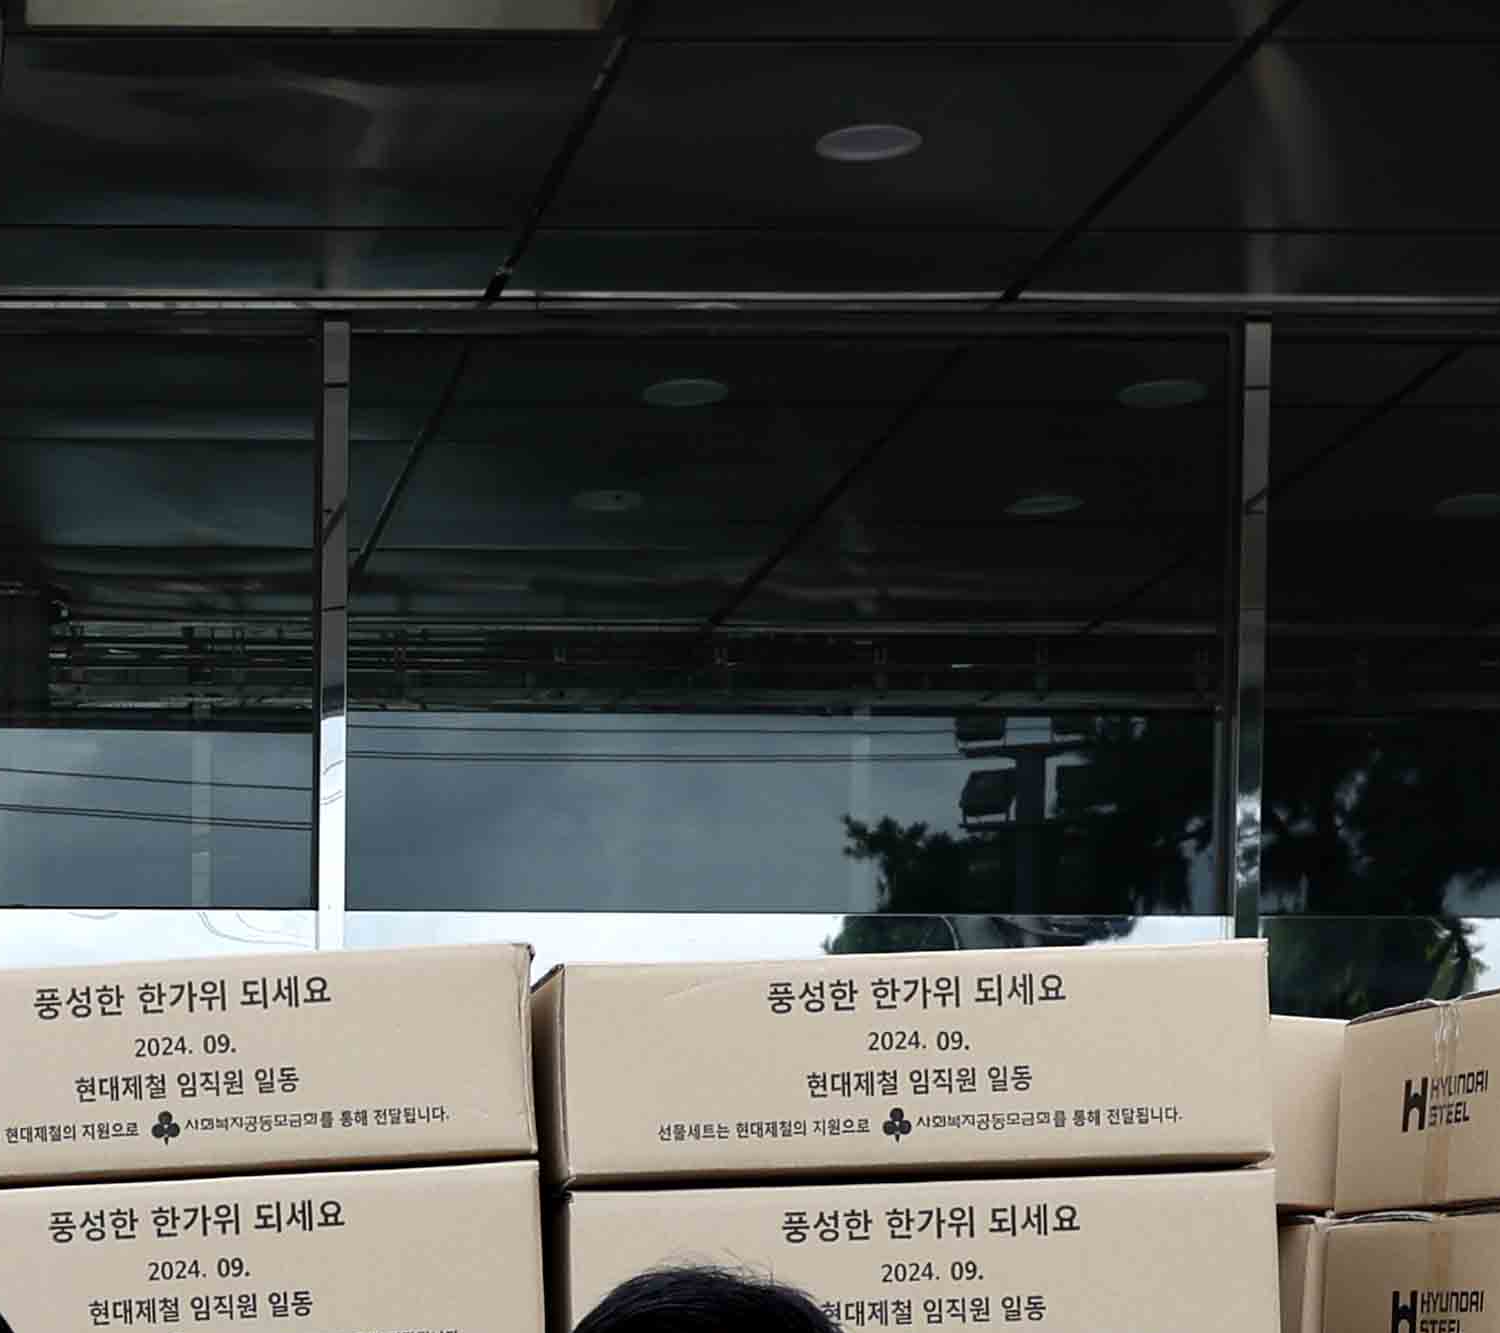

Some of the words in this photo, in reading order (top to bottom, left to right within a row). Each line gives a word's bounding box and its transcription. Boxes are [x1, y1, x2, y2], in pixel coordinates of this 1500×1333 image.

[32, 983, 126, 1021] 풍성한
[136, 978, 227, 1015] 한가위
[239, 975, 332, 1011] 되세요
[766, 978, 860, 1015] 풍성한
[869, 975, 961, 1011] 한가위
[973, 971, 1067, 1008] 되세요
[134, 1035, 193, 1059] 2024.
[202, 1032, 237, 1055] 09.
[867, 1029, 927, 1052] 2024.
[935, 1030, 971, 1052] 09.
[74, 1072, 167, 1104] 현대제철
[176, 1068, 245, 1099] 임직원
[253, 1066, 301, 1095] 일동
[805, 1069, 899, 1099] 현대제철
[908, 1066, 977, 1096] 임직원
[987, 1064, 1033, 1093] 일동
[1430, 1069, 1489, 1100] HYUNDAI
[4, 1123, 77, 1145] 현대제철의
[81, 1119, 140, 1141] 지원으로
[338, 1109, 369, 1128] 통해
[372, 1104, 450, 1126] 전달됩니다.
[657, 1122, 731, 1142] 선물세트는
[735, 1119, 807, 1139] 현대제철의
[812, 1117, 871, 1137] 지원으로
[1071, 1108, 1101, 1128] 통해
[1105, 1105, 1183, 1126] 전달됩니다.
[1427, 1101, 1471, 1127] STEEL
[1420, 1289, 1485, 1313] HYUNDAI
